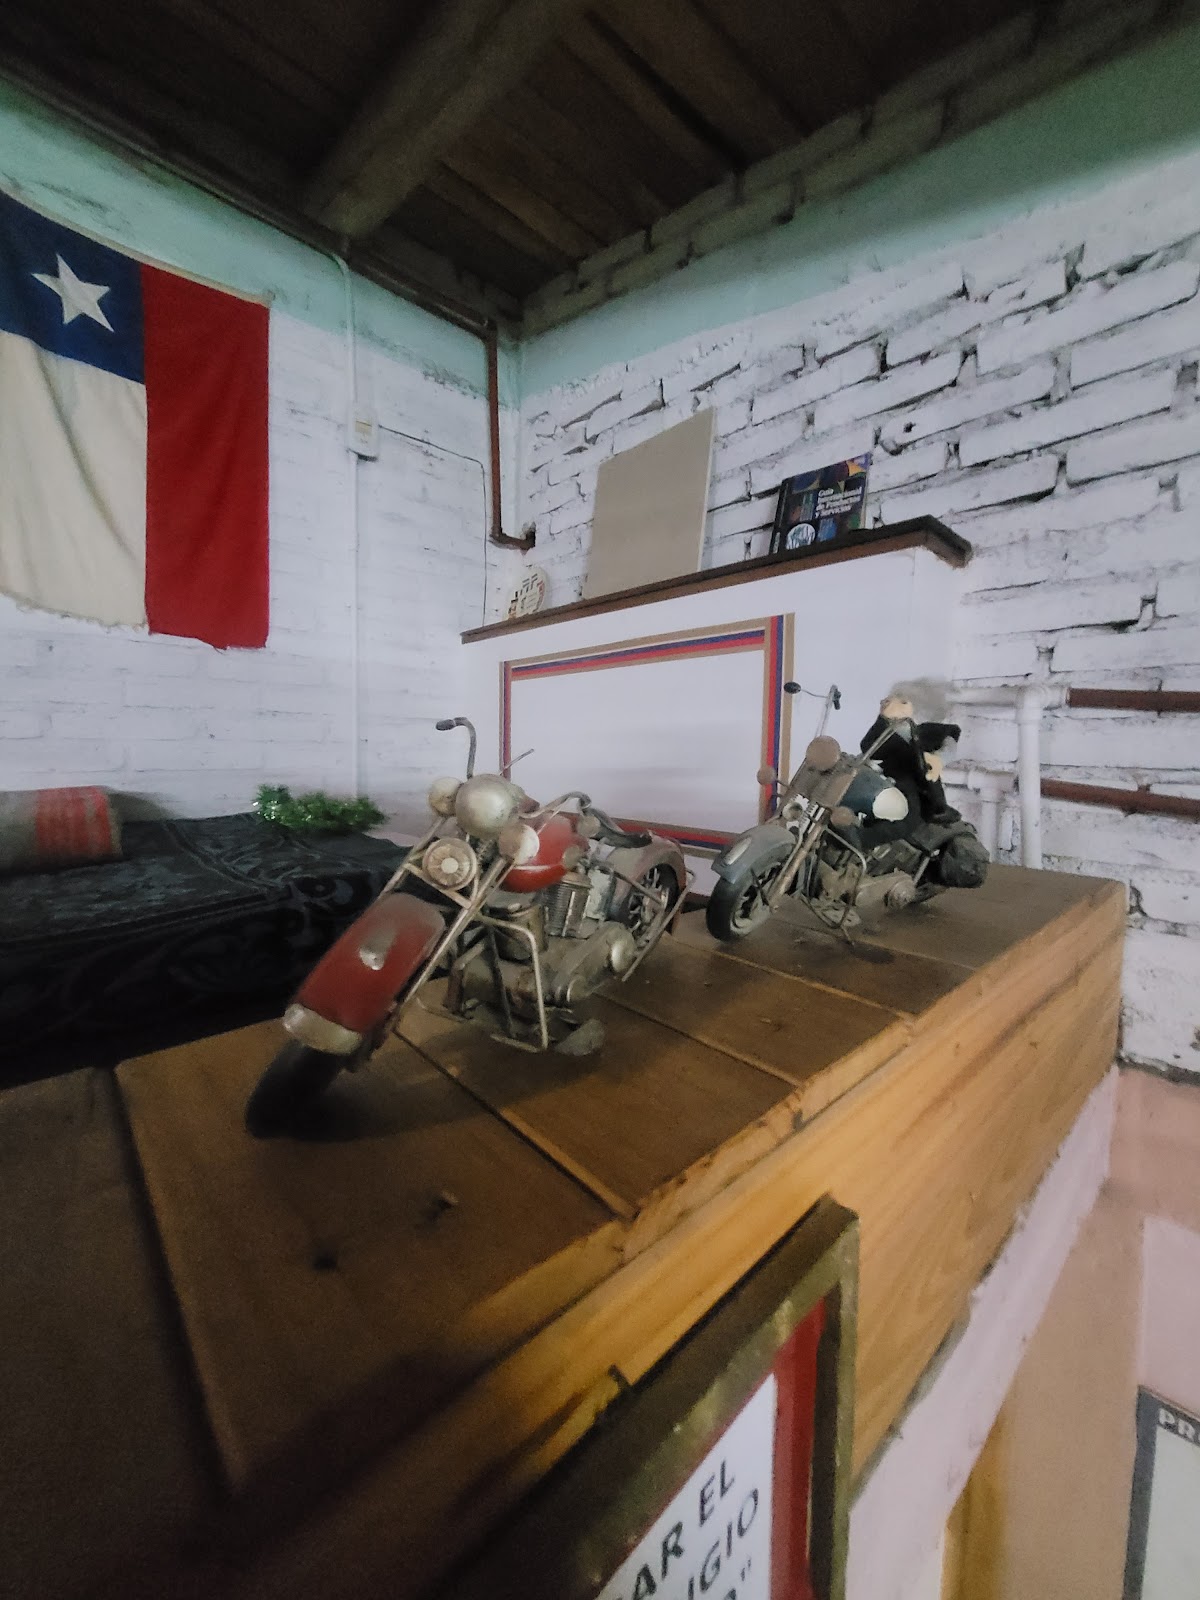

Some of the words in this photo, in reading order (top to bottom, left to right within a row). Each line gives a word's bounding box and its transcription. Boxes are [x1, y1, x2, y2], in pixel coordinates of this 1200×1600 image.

[1158, 1407, 1200, 1443] PR
[609, 1521, 686, 1600] AR
[699, 1459, 736, 1528] EL
